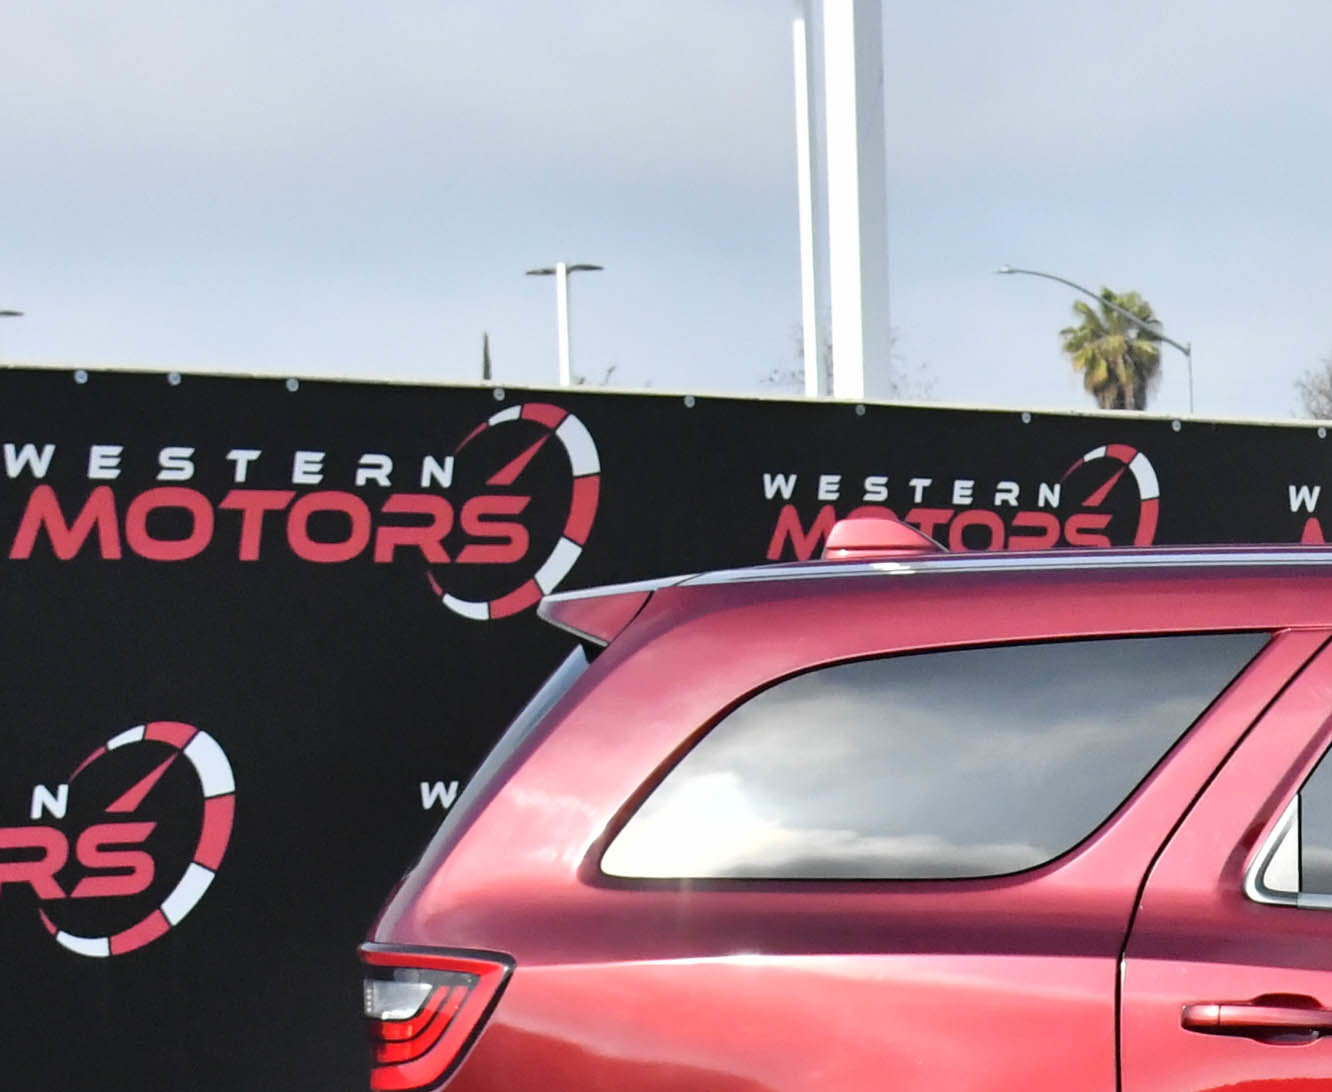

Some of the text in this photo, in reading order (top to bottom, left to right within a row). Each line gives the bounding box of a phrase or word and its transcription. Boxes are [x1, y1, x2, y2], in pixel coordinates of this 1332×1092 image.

[4, 443, 455, 488] WESTERN
[763, 473, 1061, 508] WESTERN
[9, 485, 531, 564] MOTORS
[766, 504, 1113, 562] MTORS
[30, 783, 69, 820] N
[420, 780, 459, 810] W
[0, 821, 157, 900] RS
